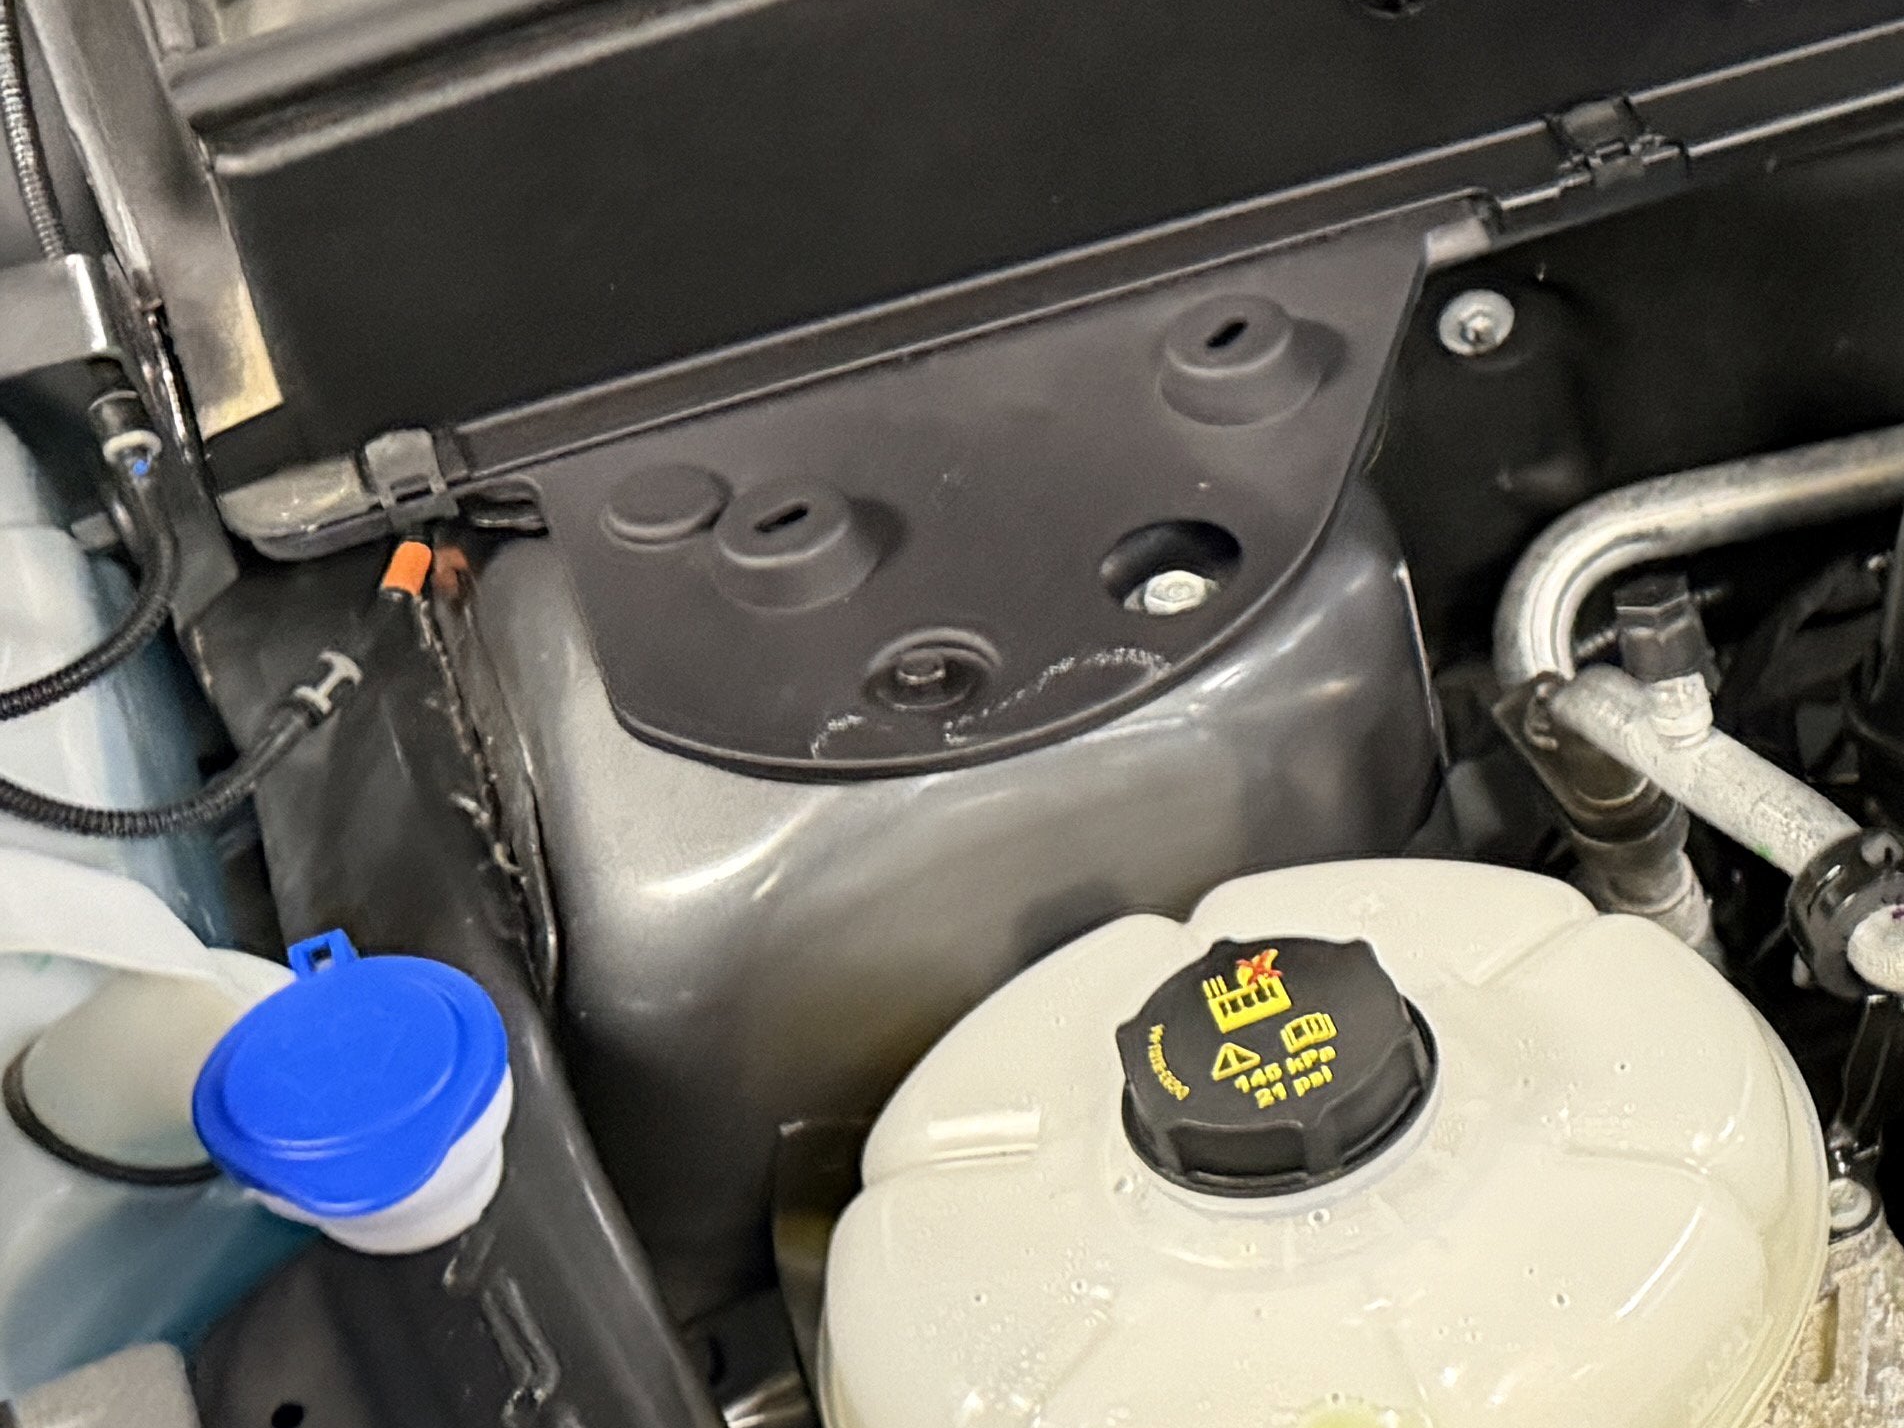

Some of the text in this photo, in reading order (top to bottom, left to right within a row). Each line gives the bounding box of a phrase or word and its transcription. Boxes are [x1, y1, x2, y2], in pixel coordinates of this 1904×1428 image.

[1285, 1045, 1338, 1076] kPa
[1254, 1064, 1334, 1109] 21 psi
